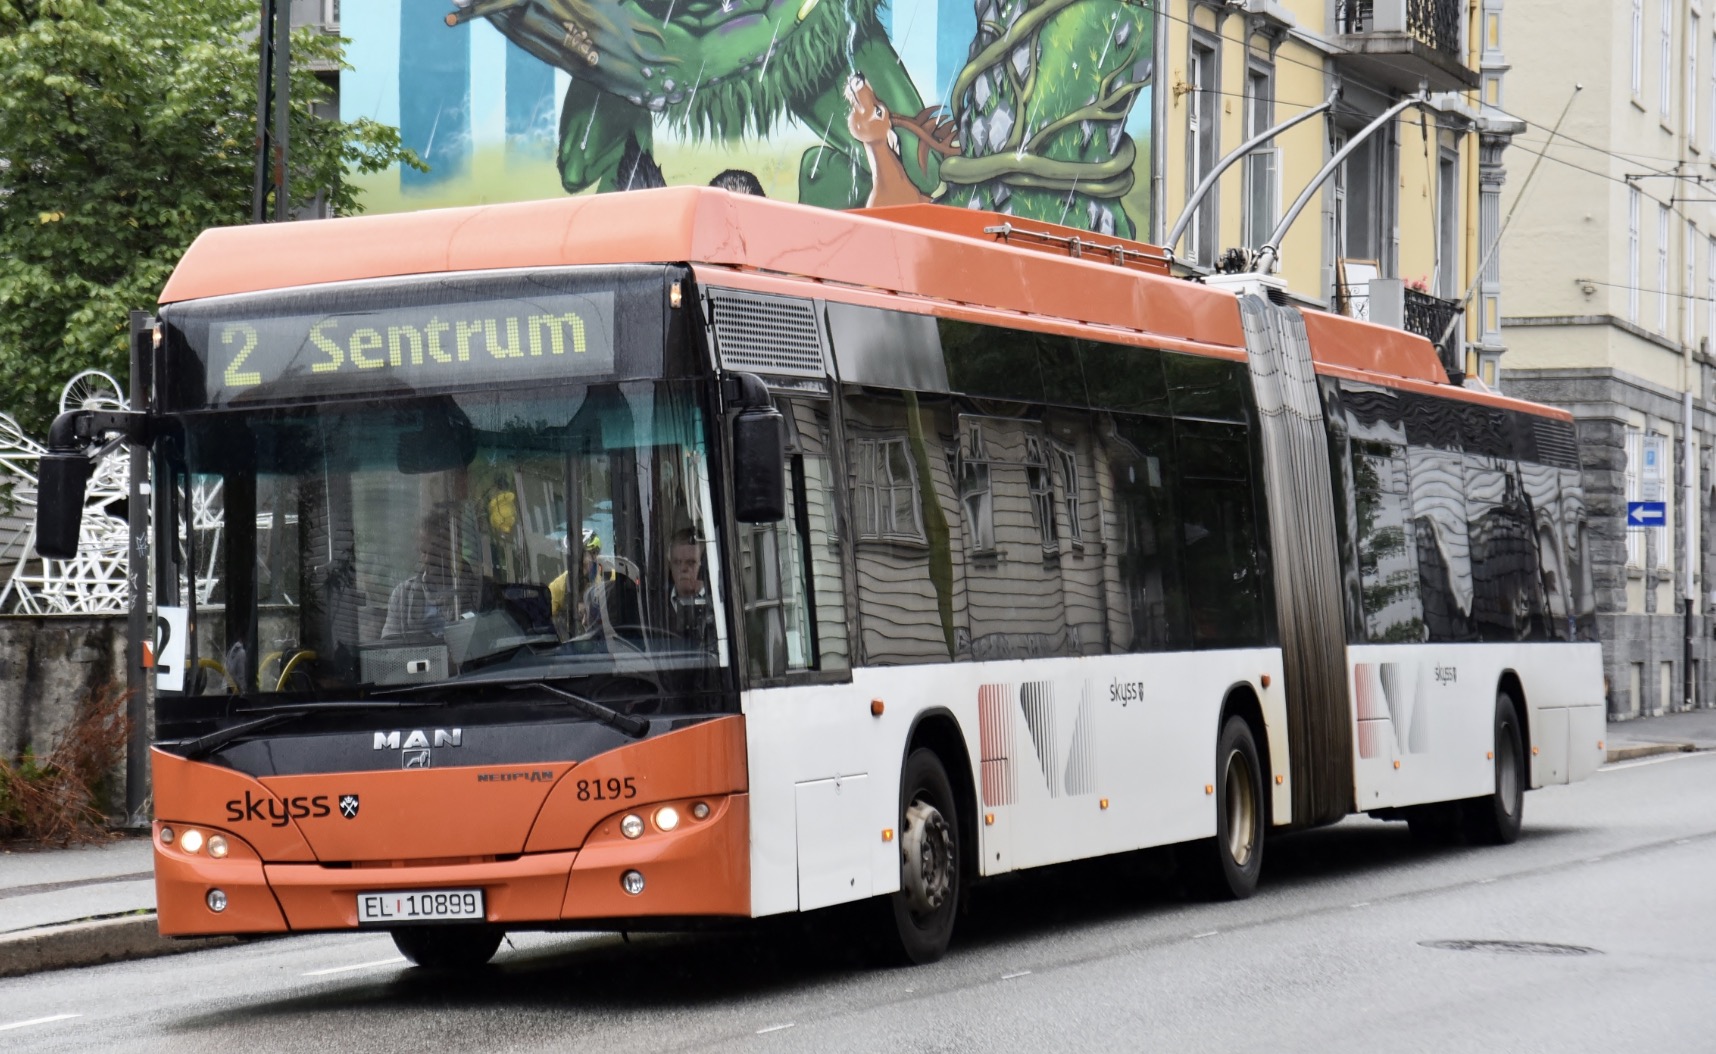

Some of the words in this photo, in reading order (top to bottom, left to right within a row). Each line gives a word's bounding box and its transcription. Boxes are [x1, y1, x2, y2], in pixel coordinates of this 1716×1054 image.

[221, 322, 261, 386] 2
[309, 312, 587, 373] Sentrum
[1109, 676, 1137, 707] skyss
[373, 728, 462, 751] MAN
[477, 771, 554, 782] NEOPLAN
[576, 777, 637, 802] 8195
[225, 790, 331, 828] skyss
[365, 897, 393, 917] EL
[406, 893, 476, 916] 10899
